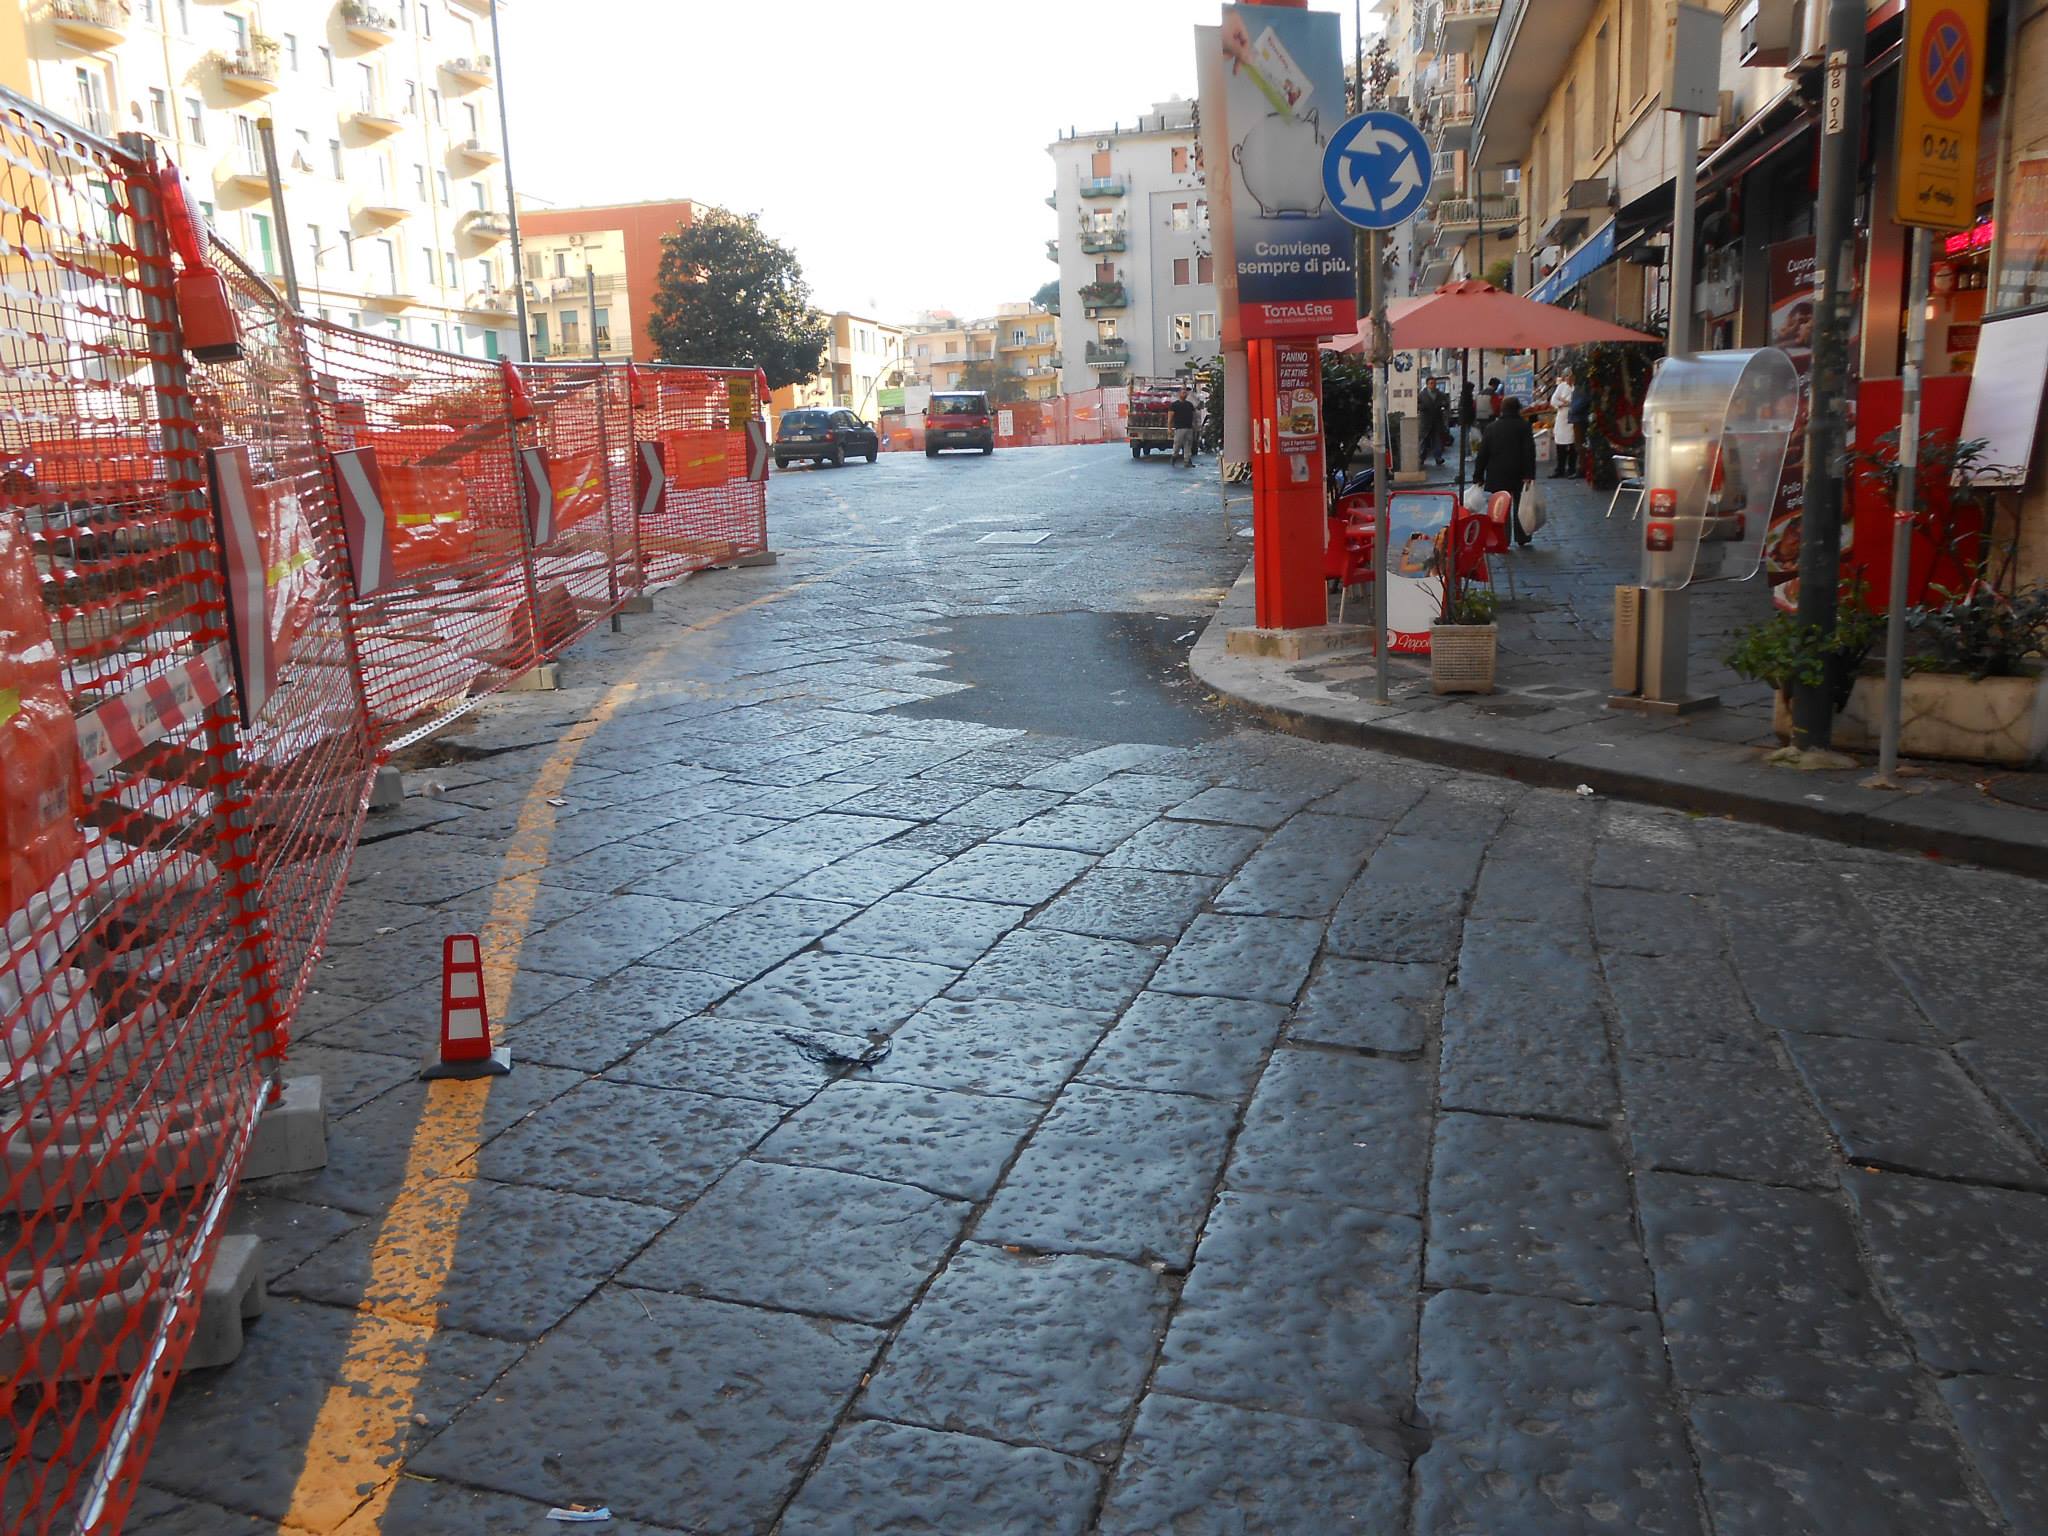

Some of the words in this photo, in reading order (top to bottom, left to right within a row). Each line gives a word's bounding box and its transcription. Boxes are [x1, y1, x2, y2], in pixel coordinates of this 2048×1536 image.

[1255, 241, 1331, 256] Conviene
[1238, 260, 1300, 277] sempre
[1304, 258, 1319, 273] di
[1322, 257, 1351, 276] più.
[1281, 351, 1308, 362] PANINO
[1280, 368, 1308, 379] PATATINE
